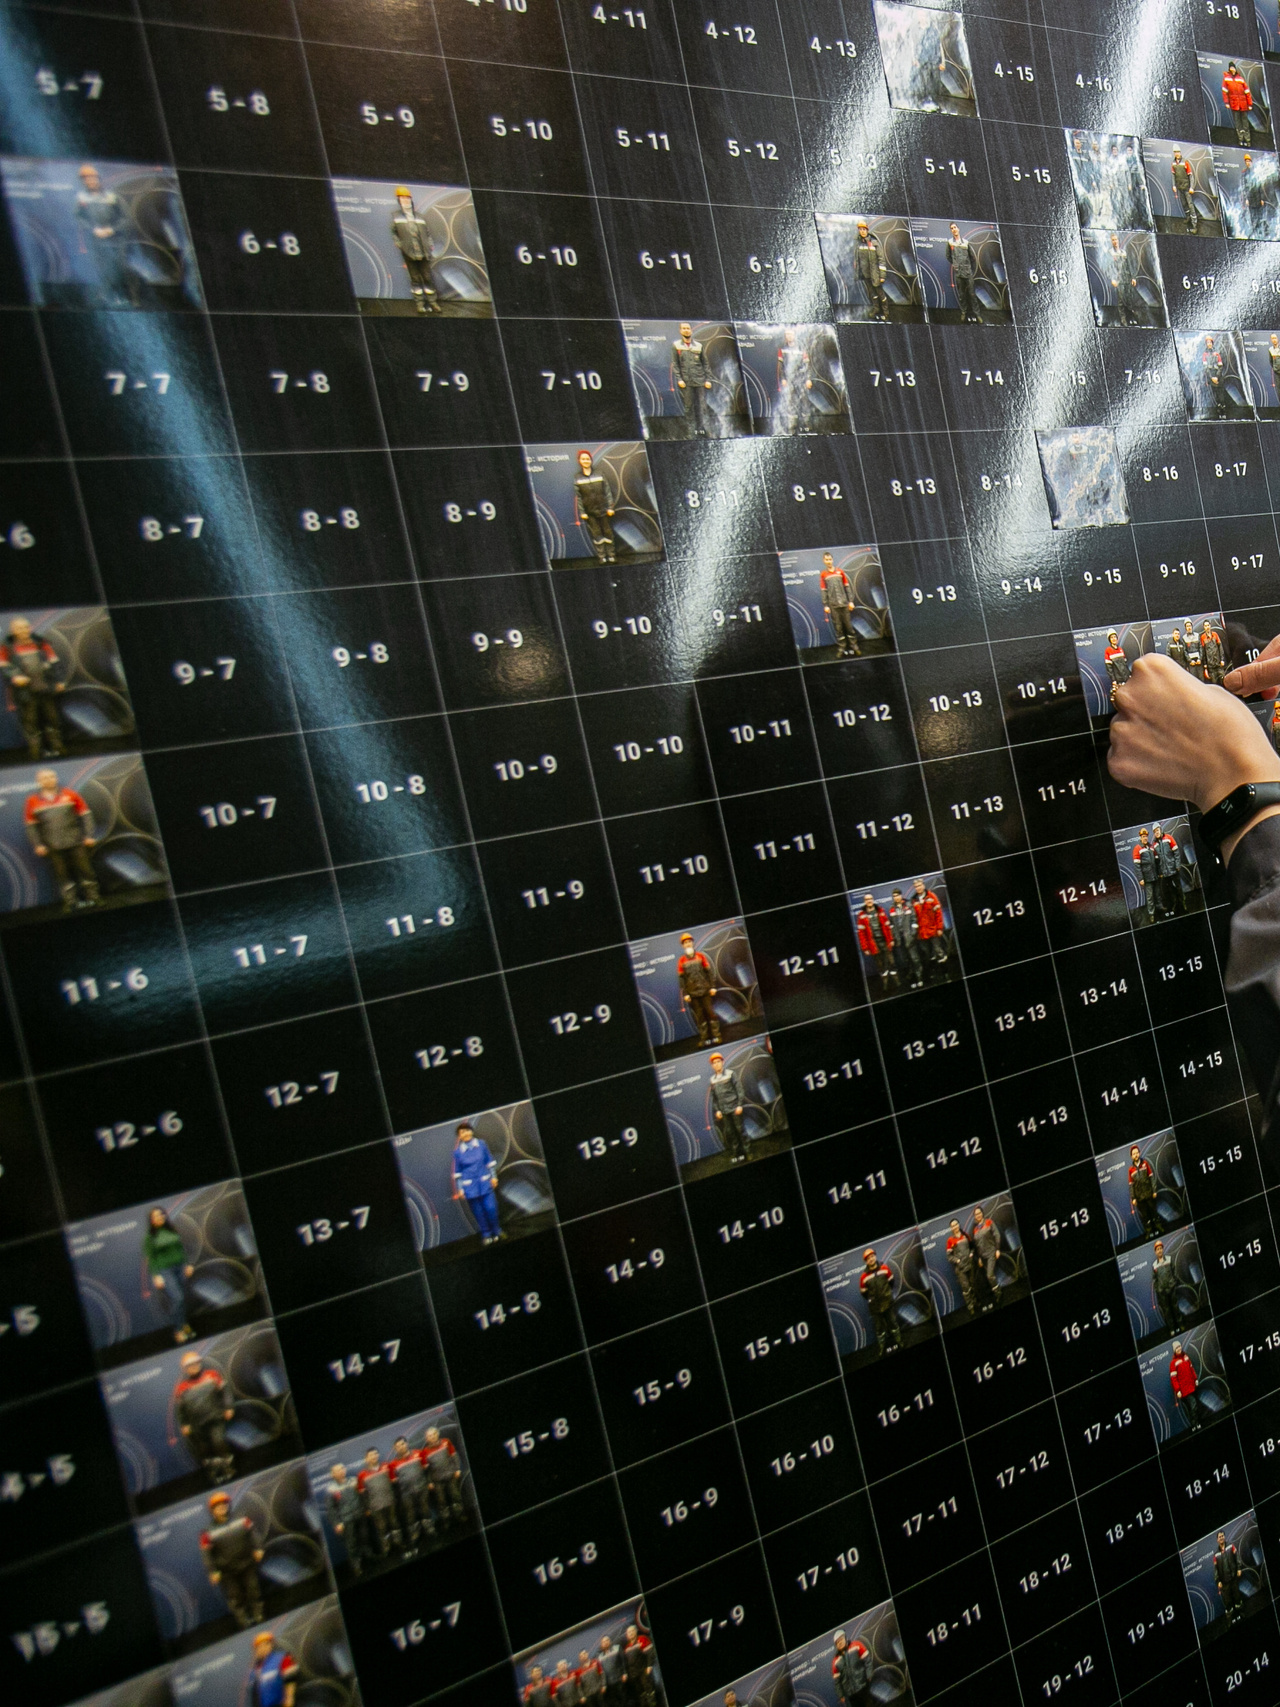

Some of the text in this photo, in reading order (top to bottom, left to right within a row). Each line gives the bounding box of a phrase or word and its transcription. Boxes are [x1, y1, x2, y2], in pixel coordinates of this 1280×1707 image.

[594, 6, 646, 29] 4-11
[1206, 0, 1239, 19] 3-18
[707, 22, 757, 44] 4-12
[811, 37, 856, 57] 4-13
[37, 67, 103, 99] 5-7
[995, 63, 1033, 81] 4-15
[209, 89, 269, 115] 5-8
[362, 105, 414, 128] 5-9
[492, 117, 552, 140] 5-10
[617, 129, 670, 150] 5-11
[728, 140, 778, 160] 5-12
[925, 158, 967, 176] 5-14
[1012, 166, 1051, 183] 5-15
[241, 233, 300, 255] 6-8
[518, 246, 577, 266] 6-10
[641, 252, 692, 270] 6-11
[1182, 276, 1215, 290] 6-17
[107, 372, 170, 394] 7-7
[271, 373, 330, 393] 7-8
[417, 372, 469, 391] 7-9
[542, 372, 601, 390] 7-10
[870, 371, 915, 386] 7-13
[962, 371, 1004, 385] 7-14
[1125, 369, 1160, 384] 7-16
[892, 478, 936, 495] 8-13
[1143, 466, 1178, 481] 8-16
[793, 483, 842, 501] 8-12
[303, 509, 359, 531] 8-8
[446, 502, 496, 522] 8-9
[143, 514, 204, 540] 8-7
[1232, 554, 1263, 570] 9-17
[1084, 569, 1121, 586] 9-15
[912, 585, 956, 604] 9-13
[595, 616, 651, 638] 9-10
[713, 605, 762, 626] 9-11
[473, 629, 523, 652] 9-9
[333, 642, 388, 667] 9-8
[175, 658, 236, 684] 9-7
[1018, 678, 1066, 698] 10-14
[930, 691, 982, 712] 10-13
[834, 704, 892, 727] 10-12
[730, 720, 791, 743] 10-11
[615, 736, 683, 762] 10-10
[496, 755, 557, 780] 10-9
[356, 775, 425, 802] 10-8
[1038, 779, 1086, 801] 11-14
[202, 797, 276, 827] 10-7
[857, 814, 914, 839] 11-12
[755, 834, 815, 860] 11-11
[641, 855, 708, 883] 11-10
[523, 880, 583, 908] 11-9
[1059, 880, 1106, 903] 12-14
[386, 907, 454, 936] 11-8
[973, 901, 1024, 925] 12-13
[234, 935, 308, 967] 11-7
[779, 947, 839, 975] 12-11
[1159, 956, 1202, 980] 13-15
[64, 967, 149, 1003] 11-6
[551, 1005, 611, 1034] 12-9
[996, 1004, 1046, 1031] 13-13
[417, 1036, 483, 1069] 12-8
[903, 1030, 959, 1059] 13-12
[804, 1059, 862, 1090] 13-11
[1180, 1051, 1222, 1077] 14-15
[267, 1072, 339, 1107] 12-7
[1102, 1077, 1148, 1105] 14-14
[99, 1112, 182, 1150] 12-6
[579, 1127, 637, 1159] 13-9
[927, 1137, 981, 1168] 14-12
[1200, 1145, 1242, 1173] 15-15
[829, 1170, 886, 1203] 14-11
[299, 1206, 370, 1244] 13-7
[720, 1207, 783, 1242] 14-10
[1040, 1208, 1089, 1239] 15-13
[607, 1249, 664, 1282] 14-9
[1220, 1239, 1261, 1268] 16-15
[476, 1292, 541, 1329] 14-8
[1062, 1309, 1110, 1342] 16-13
[746, 1322, 808, 1359] 15-10
[1240, 1331, 1280, 1363] 17-15
[331, 1339, 400, 1380] 14-7
[974, 1348, 1026, 1382] 16-12
[634, 1369, 691, 1404] 15-9
[878, 1389, 933, 1426] 16-11
[505, 1418, 569, 1457] 15-8
[1084, 1408, 1132, 1443] 17-13
[772, 1435, 834, 1475] 16-10
[1186, 1464, 1229, 1498] 18-14
[662, 1488, 718, 1525] 16-9
[903, 1496, 957, 1536] 17-11
[535, 1542, 597, 1584] 16-8
[798, 1547, 859, 1590] 17-10
[1020, 1553, 1071, 1592] 18-12
[392, 1602, 461, 1649] 16-7
[689, 1605, 744, 1645] 17-9
[927, 1604, 981, 1645] 18-11
[1128, 1605, 1174, 1643] 19-13
[1043, 1656, 1093, 1696] 19-12
[1226, 1652, 1269, 1691] 20-14
